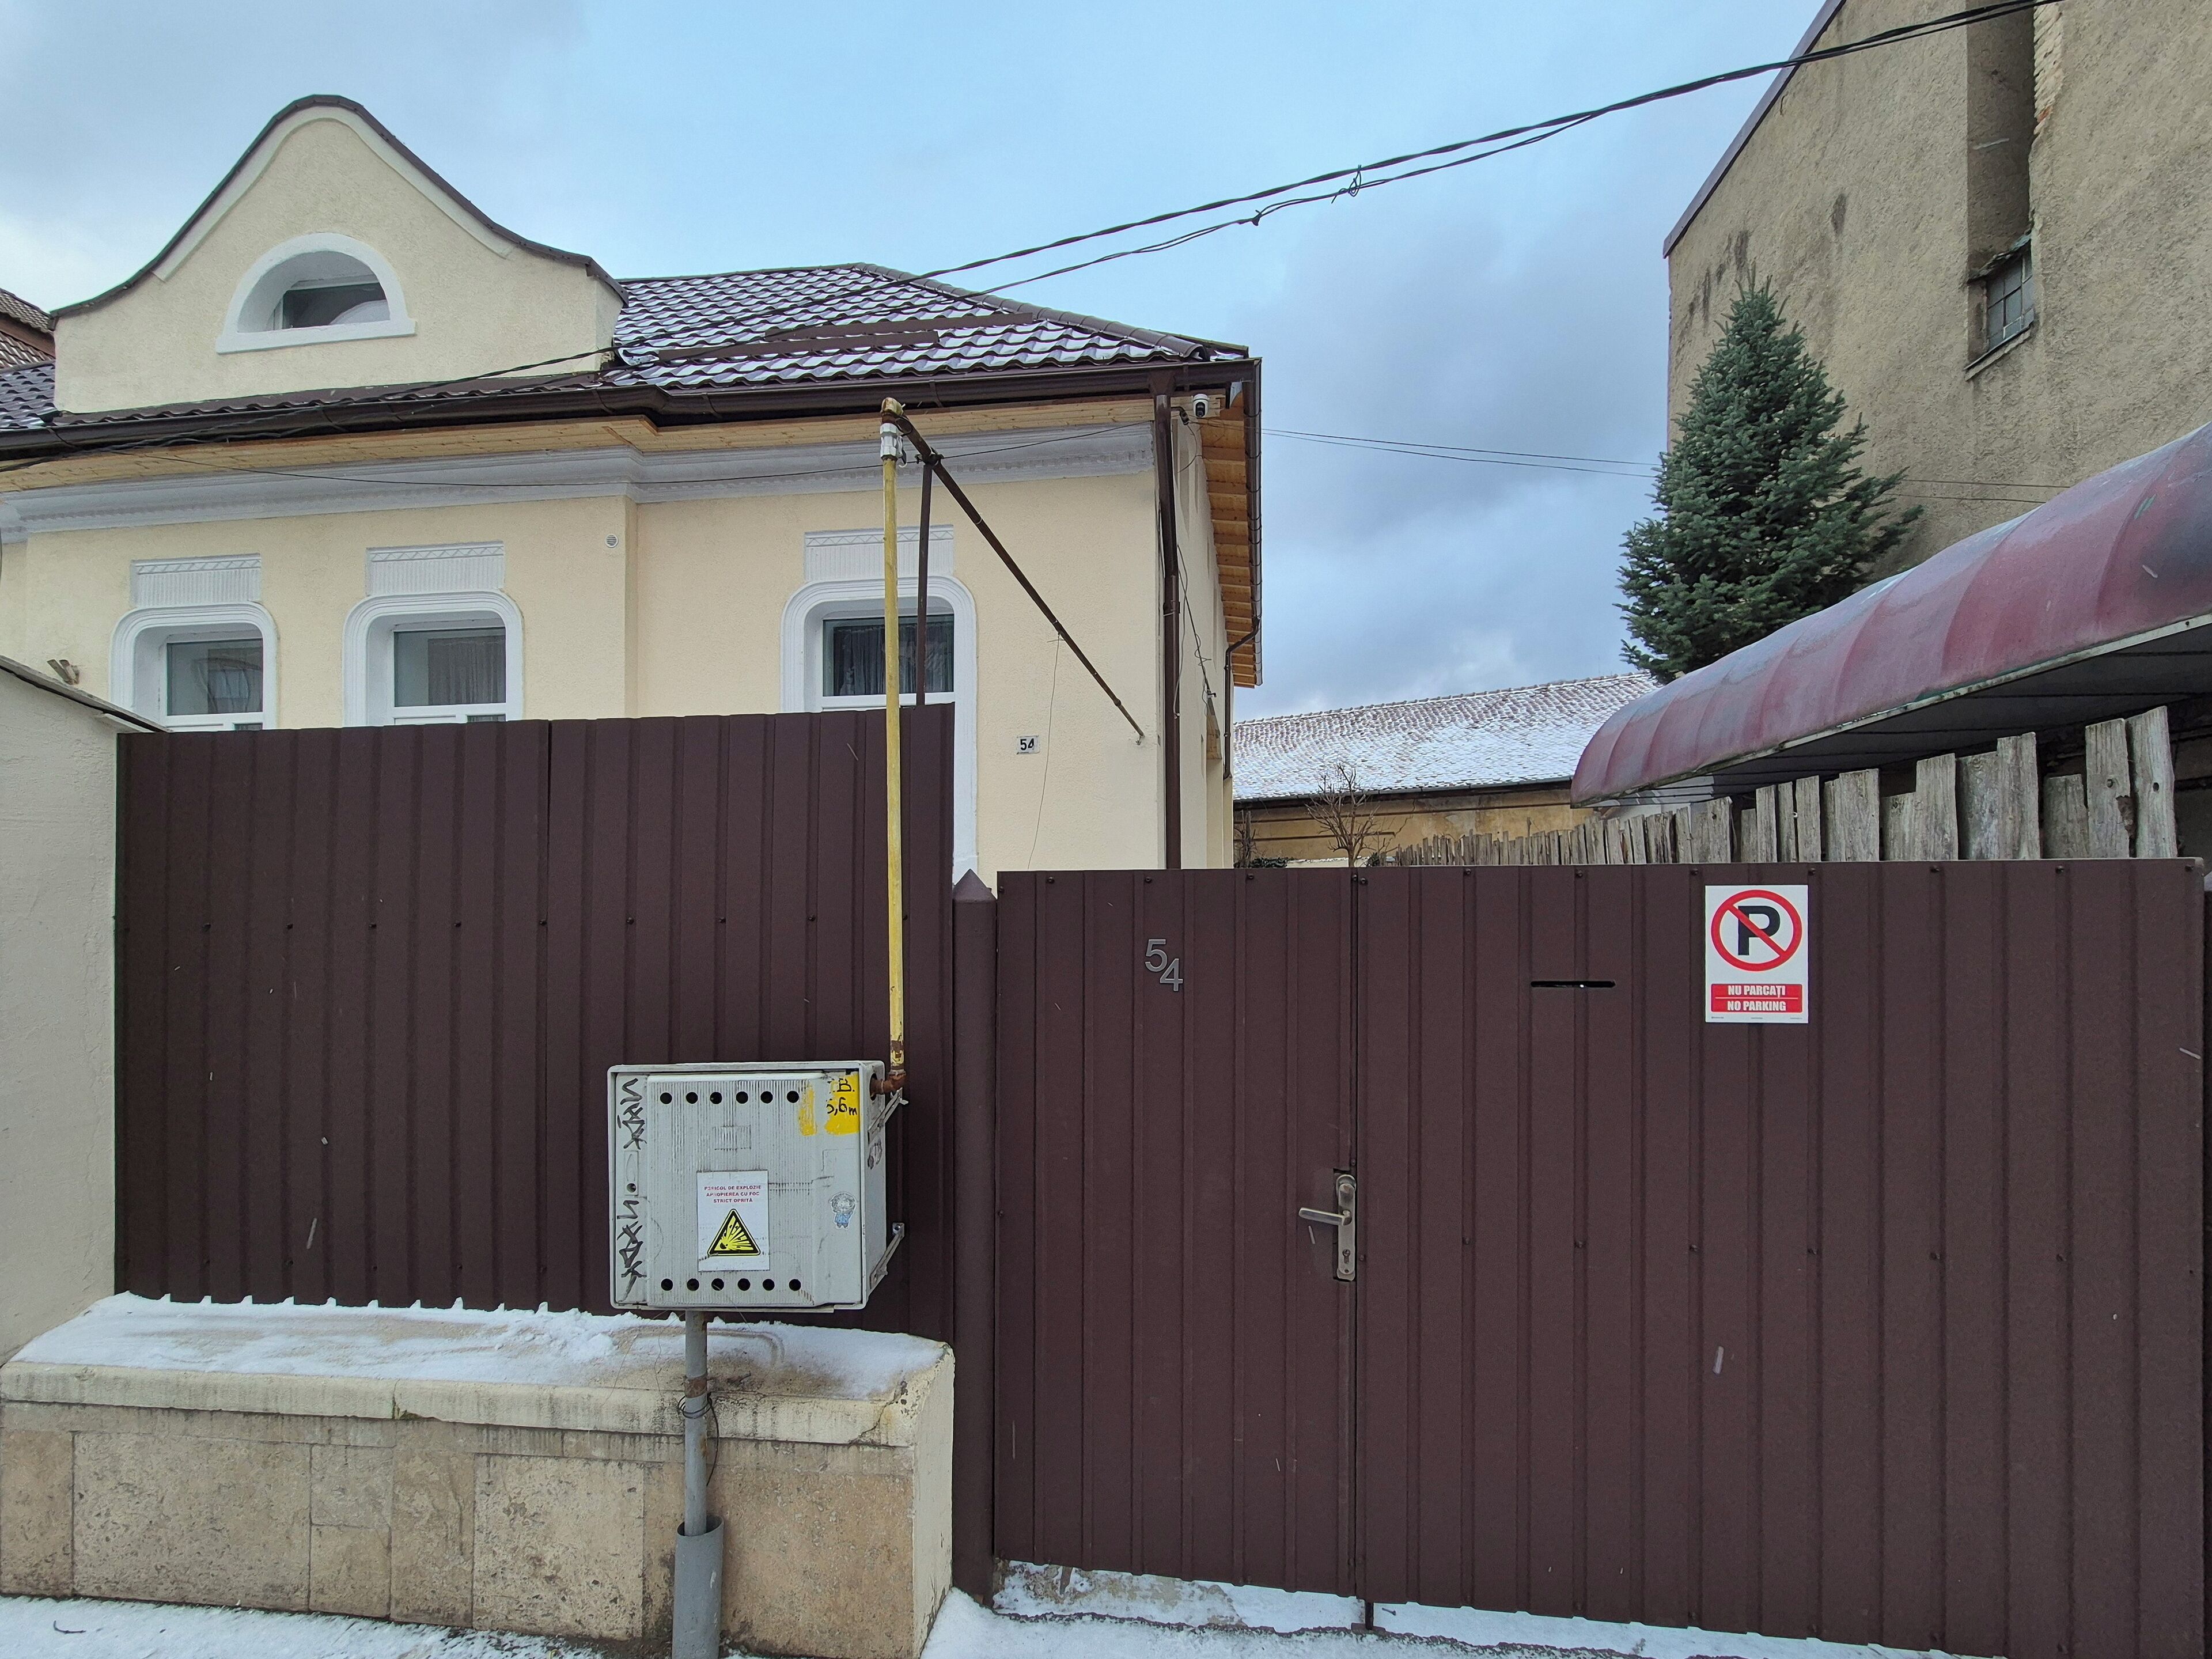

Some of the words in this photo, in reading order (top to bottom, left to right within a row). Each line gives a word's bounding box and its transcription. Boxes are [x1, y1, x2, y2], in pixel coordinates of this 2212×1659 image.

[1020, 738, 1035, 751] 54
[1145, 938, 1183, 991] 54
[1728, 984, 1742, 995] NU
[1727, 1000, 1741, 1011] NO
[1743, 1001, 1786, 1011] PARKING
